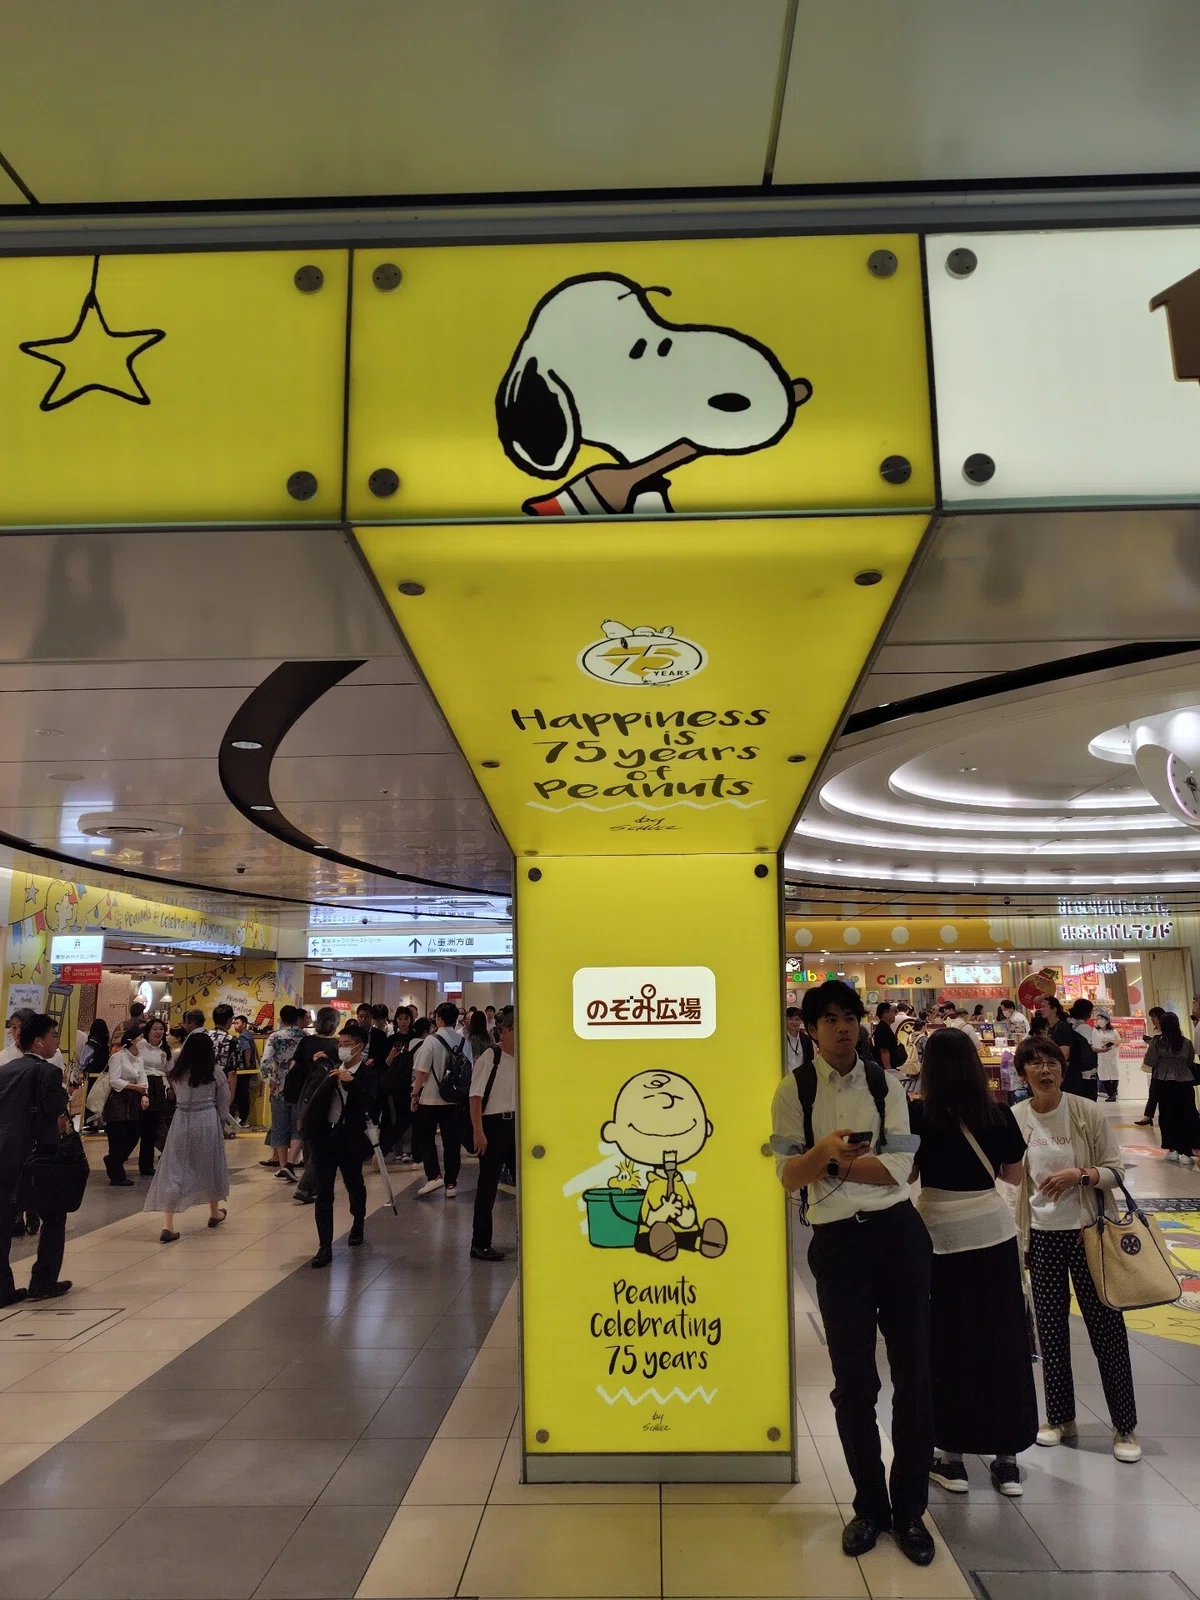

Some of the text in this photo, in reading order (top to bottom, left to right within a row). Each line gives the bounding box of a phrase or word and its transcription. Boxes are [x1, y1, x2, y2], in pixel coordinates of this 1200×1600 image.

[511, 708, 770, 737] Happiness
[663, 730, 697, 746] is
[532, 740, 760, 769] 75 years
[533, 773, 753, 800] Peanuts
[626, 765, 672, 781] of
[634, 815, 666, 826] by
[124, 902, 152, 928] Peanuts
[160, 911, 197, 937] Celebrating
[427, 937, 475, 947] 八重洲方面
[586, 995, 702, 1022] のぞみ広場
[613, 1275, 698, 1307] Peanuts
[590, 1308, 722, 1346] Celebrating
[605, 1344, 709, 1379] 75 years
[651, 1410, 665, 1424] by
